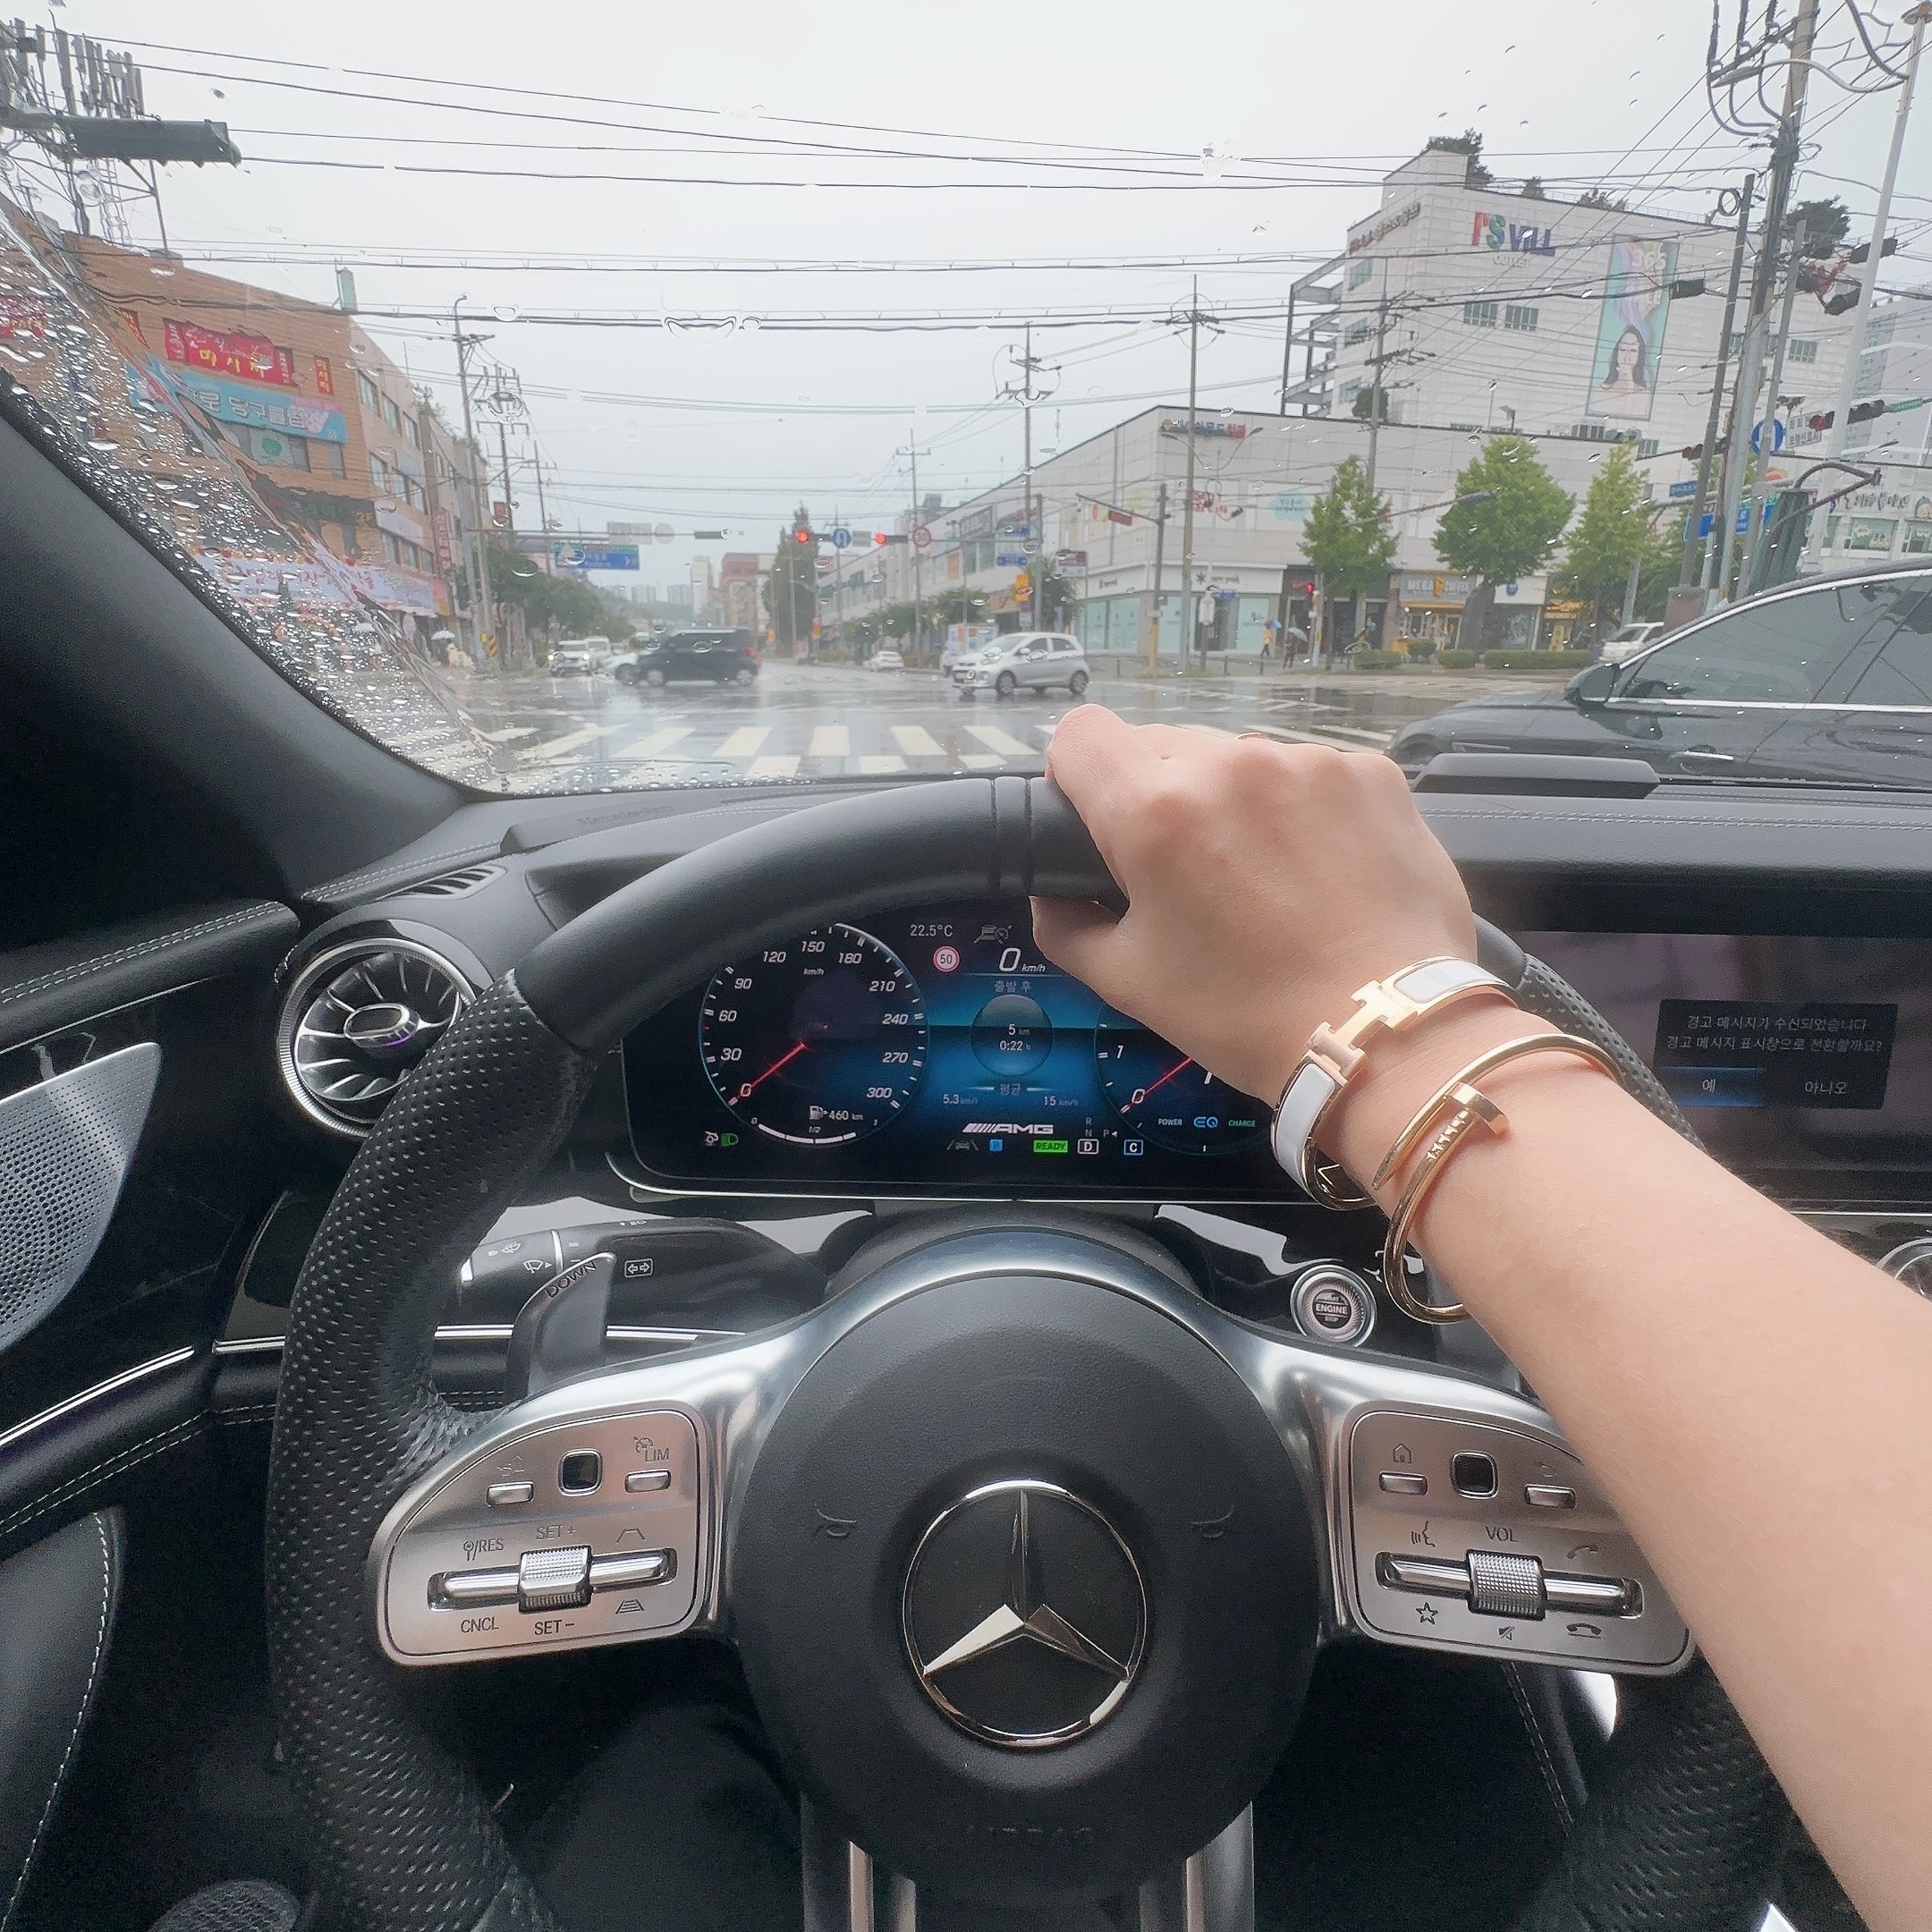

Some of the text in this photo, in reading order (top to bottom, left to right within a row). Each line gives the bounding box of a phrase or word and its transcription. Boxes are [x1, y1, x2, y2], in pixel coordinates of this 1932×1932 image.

[1493, 254, 1530, 268] OUTLET
[910, 924, 953, 937] 22.5°C
[801, 940, 826, 953] 150
[763, 951, 787, 963] 120
[838, 952, 862, 964] 180
[940, 953, 953, 964] 50
[998, 947, 1046, 972] 0 km/h
[734, 978, 752, 989] 90
[869, 980, 895, 992] 210
[994, 979, 1031, 993] 출발 후
[718, 1009, 738, 1021] 60
[882, 1013, 909, 1025] 240
[1008, 1023, 1016, 1036] 5
[1688, 1015, 1867, 1032] 경고 메시지가 수신되었습니다
[999, 1040, 1023, 1051] 0:22
[1666, 1035, 1882, 1053] 경고 메시지 표시창으로 전환할까요?
[720, 1047, 742, 1061] 30
[882, 1052, 909, 1063] 270
[740, 1083, 751, 1097] 0
[1000, 1082, 1021, 1096] 평균
[1702, 1079, 1716, 1092] 예
[1805, 1080, 1846, 1094] 아니오
[866, 1087, 893, 1098] 300
[1131, 1089, 1145, 1104] 0
[943, 1093, 960, 1105] 5.3
[1044, 1096, 1056, 1106] 15
[828, 1110, 849, 1120] 460
[1157, 1118, 1182, 1126] POWER
[1228, 1119, 1256, 1128] CHARGE
[991, 1123, 1054, 1135] AMG
[1035, 1143, 1066, 1151] READY
[1083, 1140, 1092, 1152] D
[1129, 1142, 1138, 1152] C
[544, 1259, 597, 1298] DOWN
[1316, 1303, 1348, 1315] ENGINE
[645, 1447, 670, 1462] LIM
[537, 1524, 563, 1540] SET
[1486, 1526, 1519, 1543] VOL
[461, 1616, 499, 1633] CNCL
[534, 1620, 563, 1635] SET
